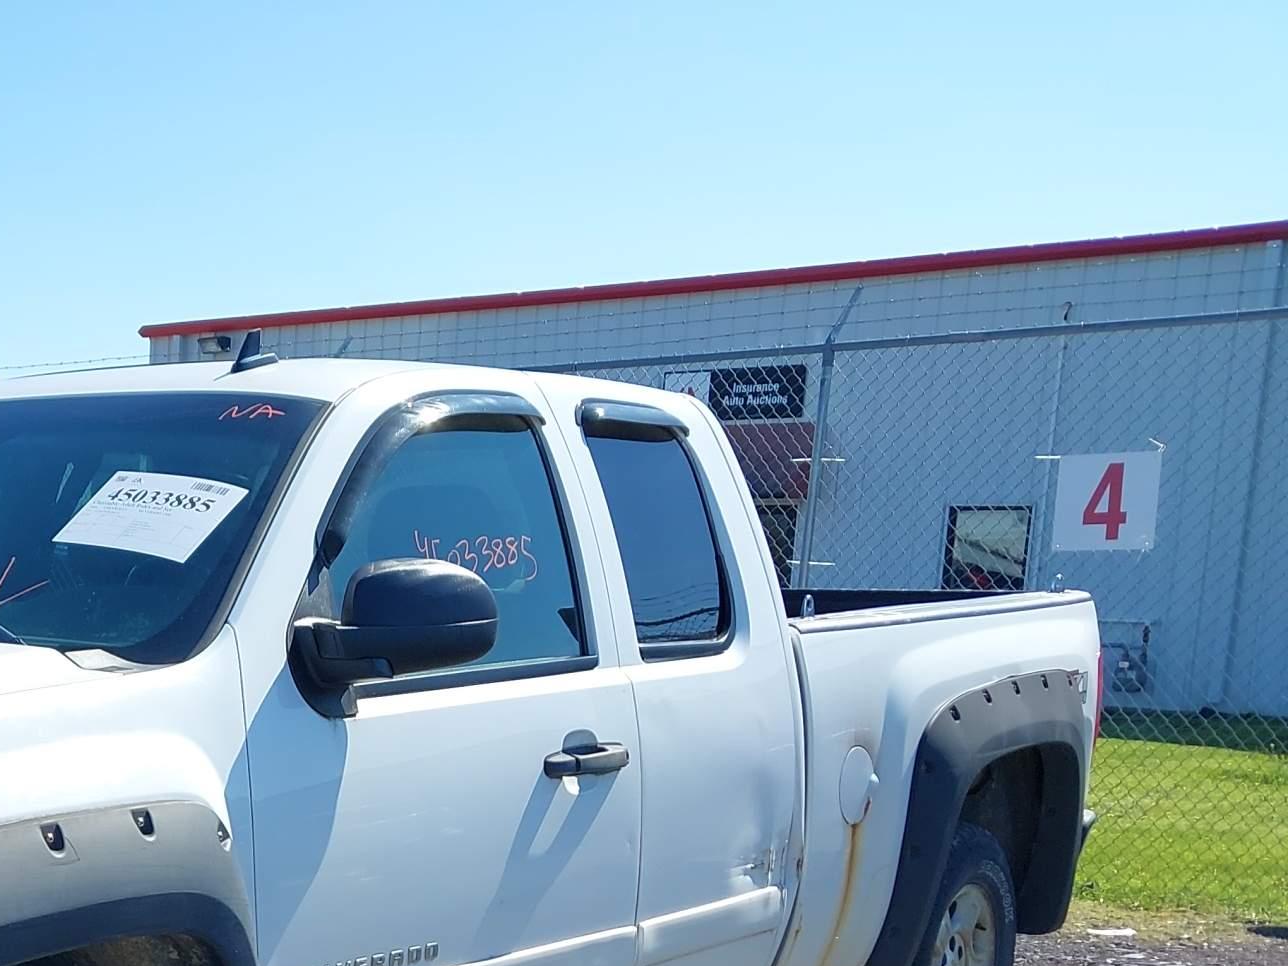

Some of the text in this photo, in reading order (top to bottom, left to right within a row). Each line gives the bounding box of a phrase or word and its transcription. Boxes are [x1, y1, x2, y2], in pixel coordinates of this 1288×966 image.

[732, 382, 780, 394] Insurance
[723, 394, 788, 406] Auto Auctions
[218, 403, 286, 420] NA
[107, 487, 217, 513] 45033885
[1082, 462, 1127, 540] 4
